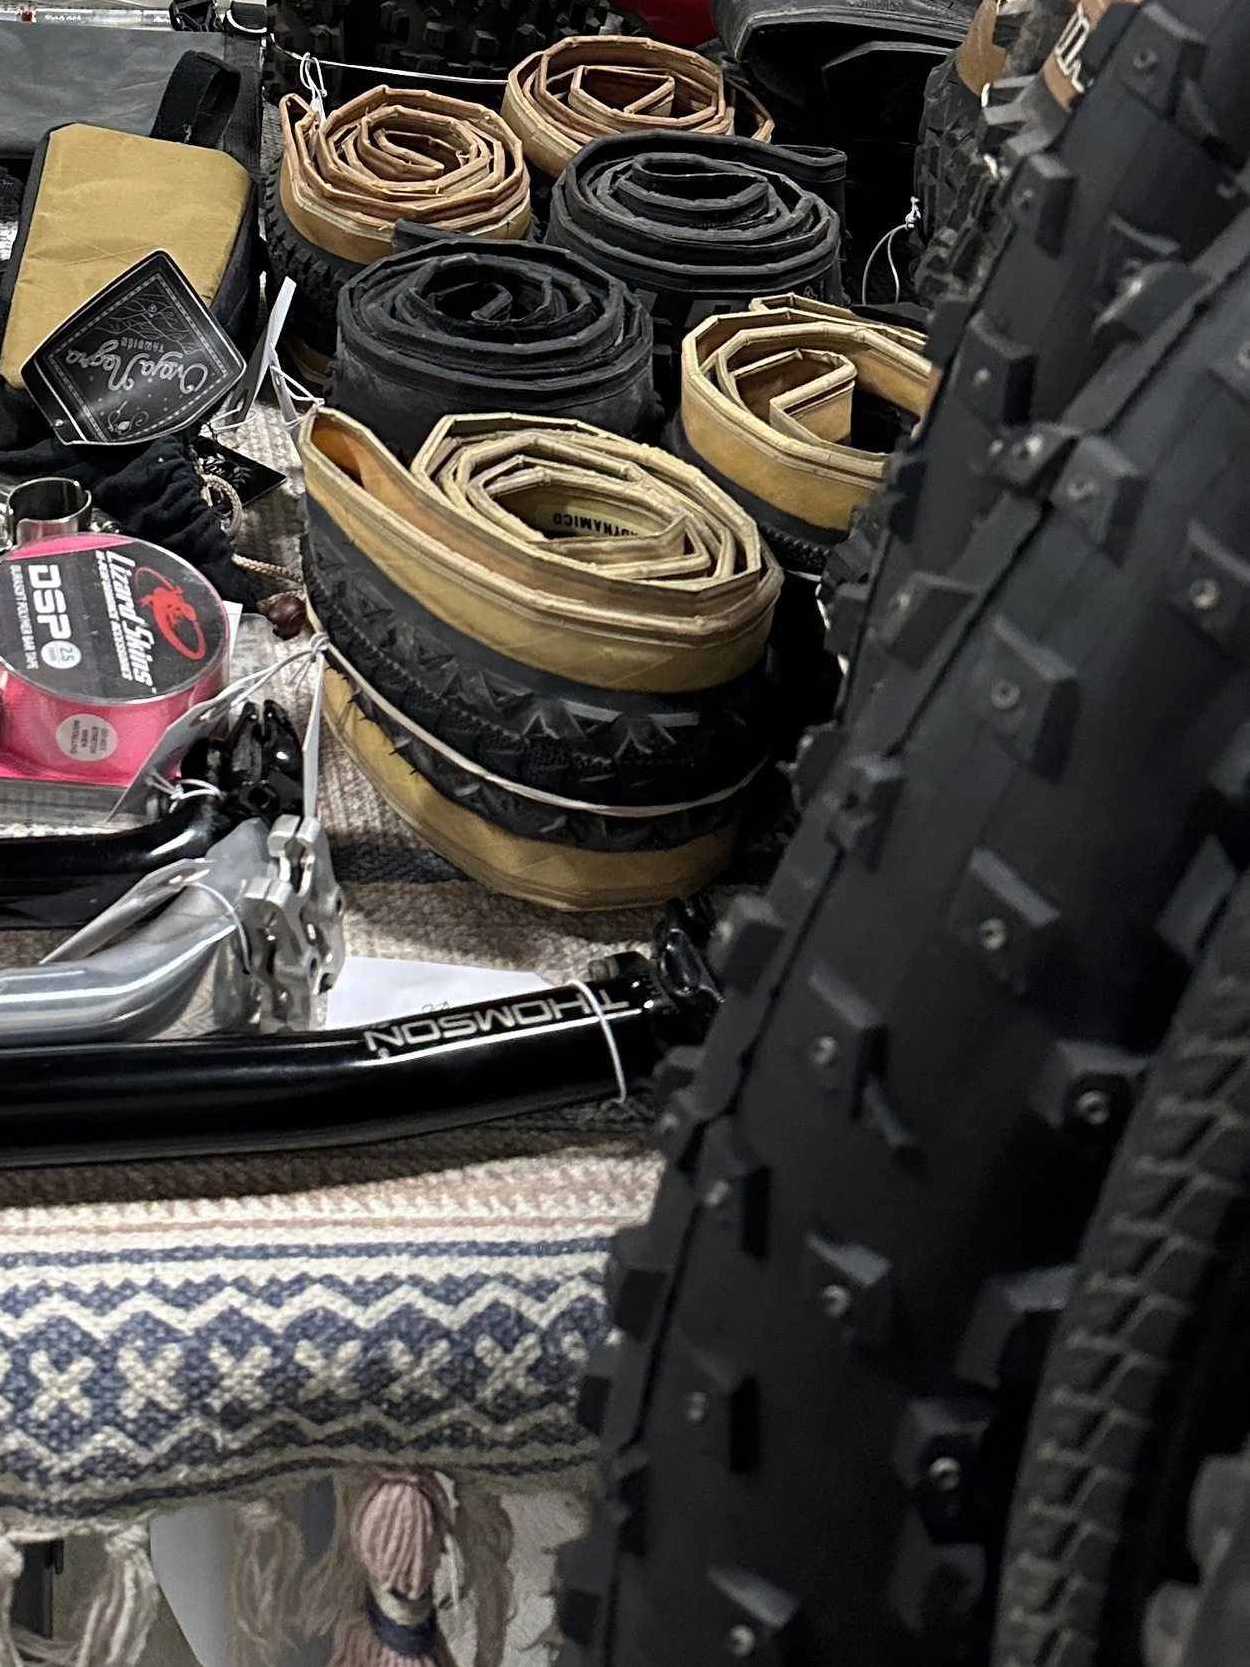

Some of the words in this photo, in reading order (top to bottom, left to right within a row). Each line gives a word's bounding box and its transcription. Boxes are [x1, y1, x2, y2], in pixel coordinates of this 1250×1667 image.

[65, 339, 150, 391] Negra
[139, 350, 209, 394] Oveja
[553, 512, 639, 537] DYNAMICO
[27, 564, 72, 640] DSP
[106, 549, 146, 626] Lizard
[121, 618, 155, 686] Skins
[363, 989, 630, 1052] THOMSON
